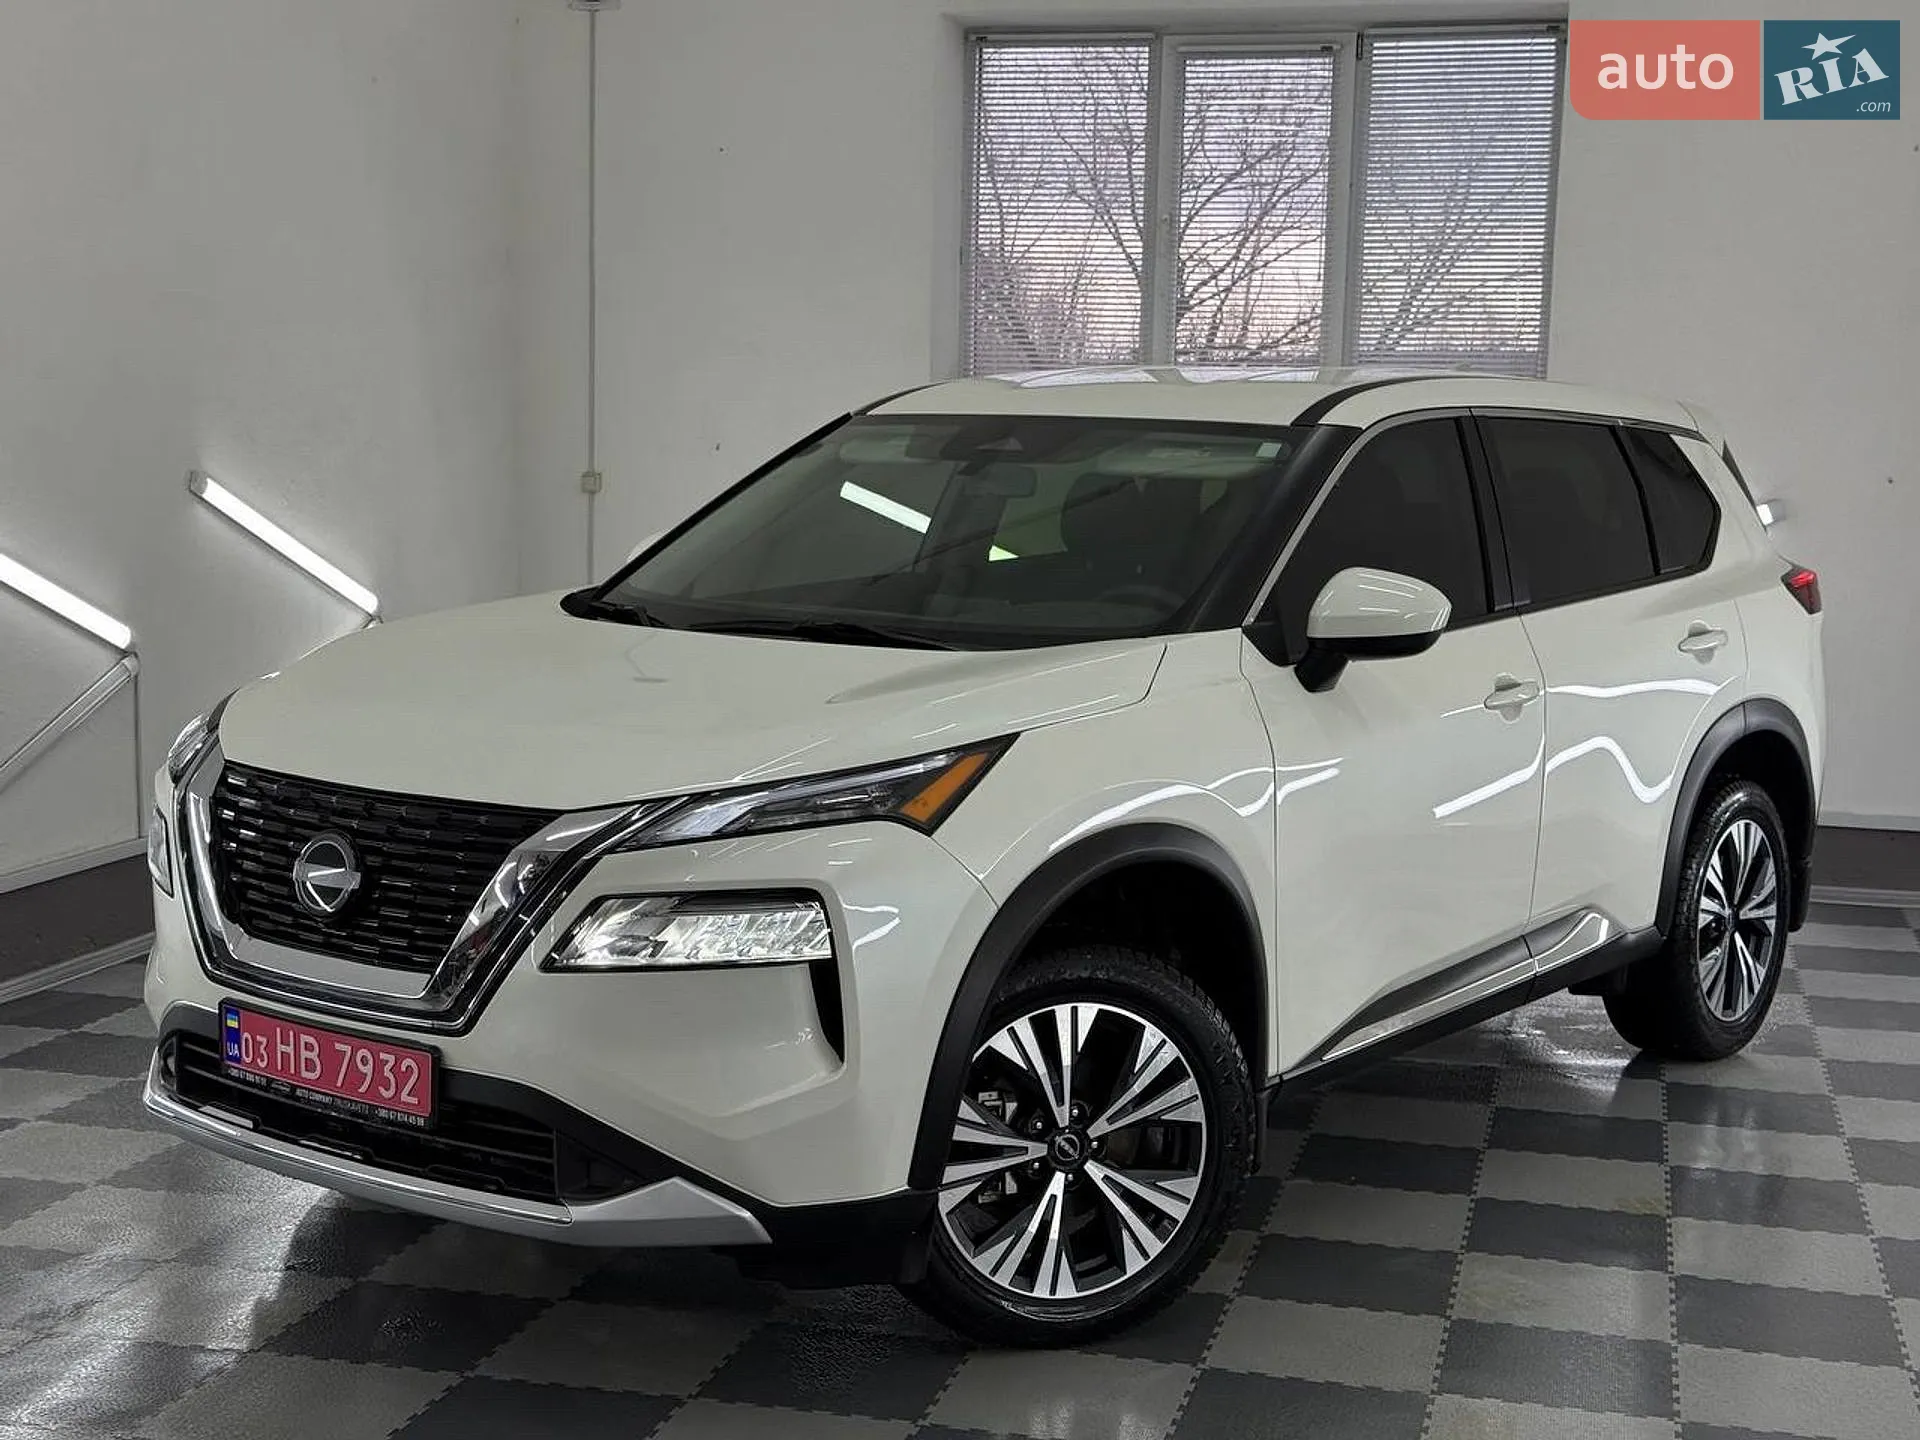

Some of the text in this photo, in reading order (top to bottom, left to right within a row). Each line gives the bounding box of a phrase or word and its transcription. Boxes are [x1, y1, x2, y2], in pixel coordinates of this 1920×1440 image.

[226, 1041, 240, 1057] UA
[241, 1027, 420, 1105] 03 HB 7932
